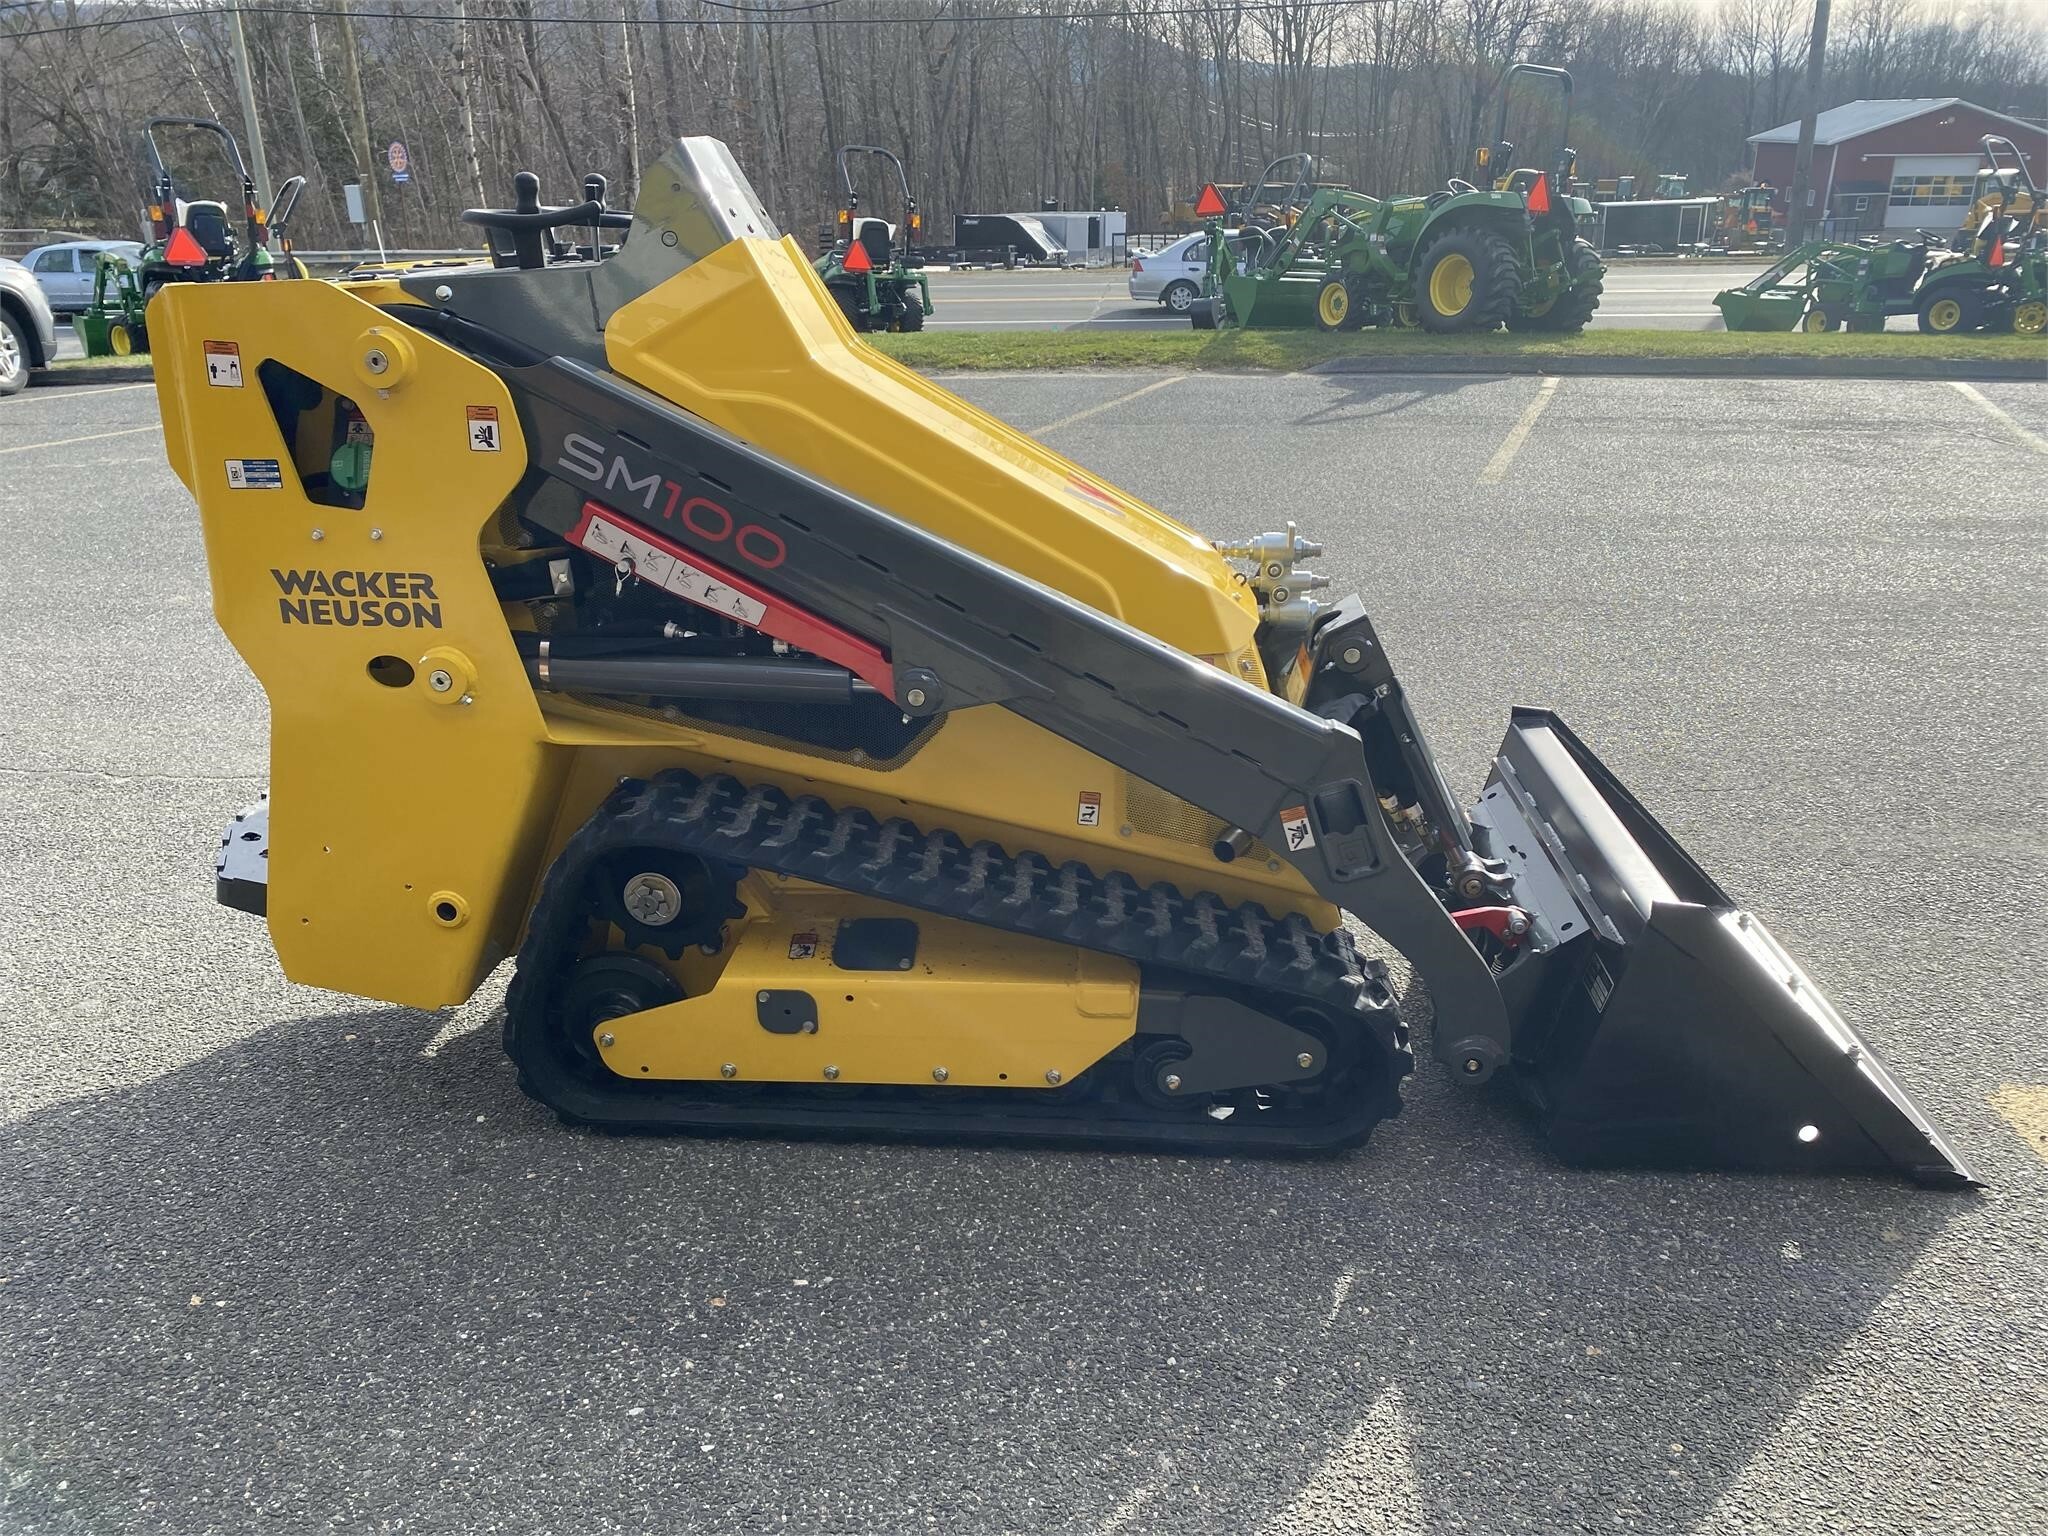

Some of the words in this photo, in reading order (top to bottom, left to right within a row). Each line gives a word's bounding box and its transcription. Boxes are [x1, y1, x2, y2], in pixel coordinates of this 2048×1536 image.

[558, 433, 786, 569] SM100
[270, 569, 439, 599] WACKER
[279, 598, 442, 628] NEUSON
